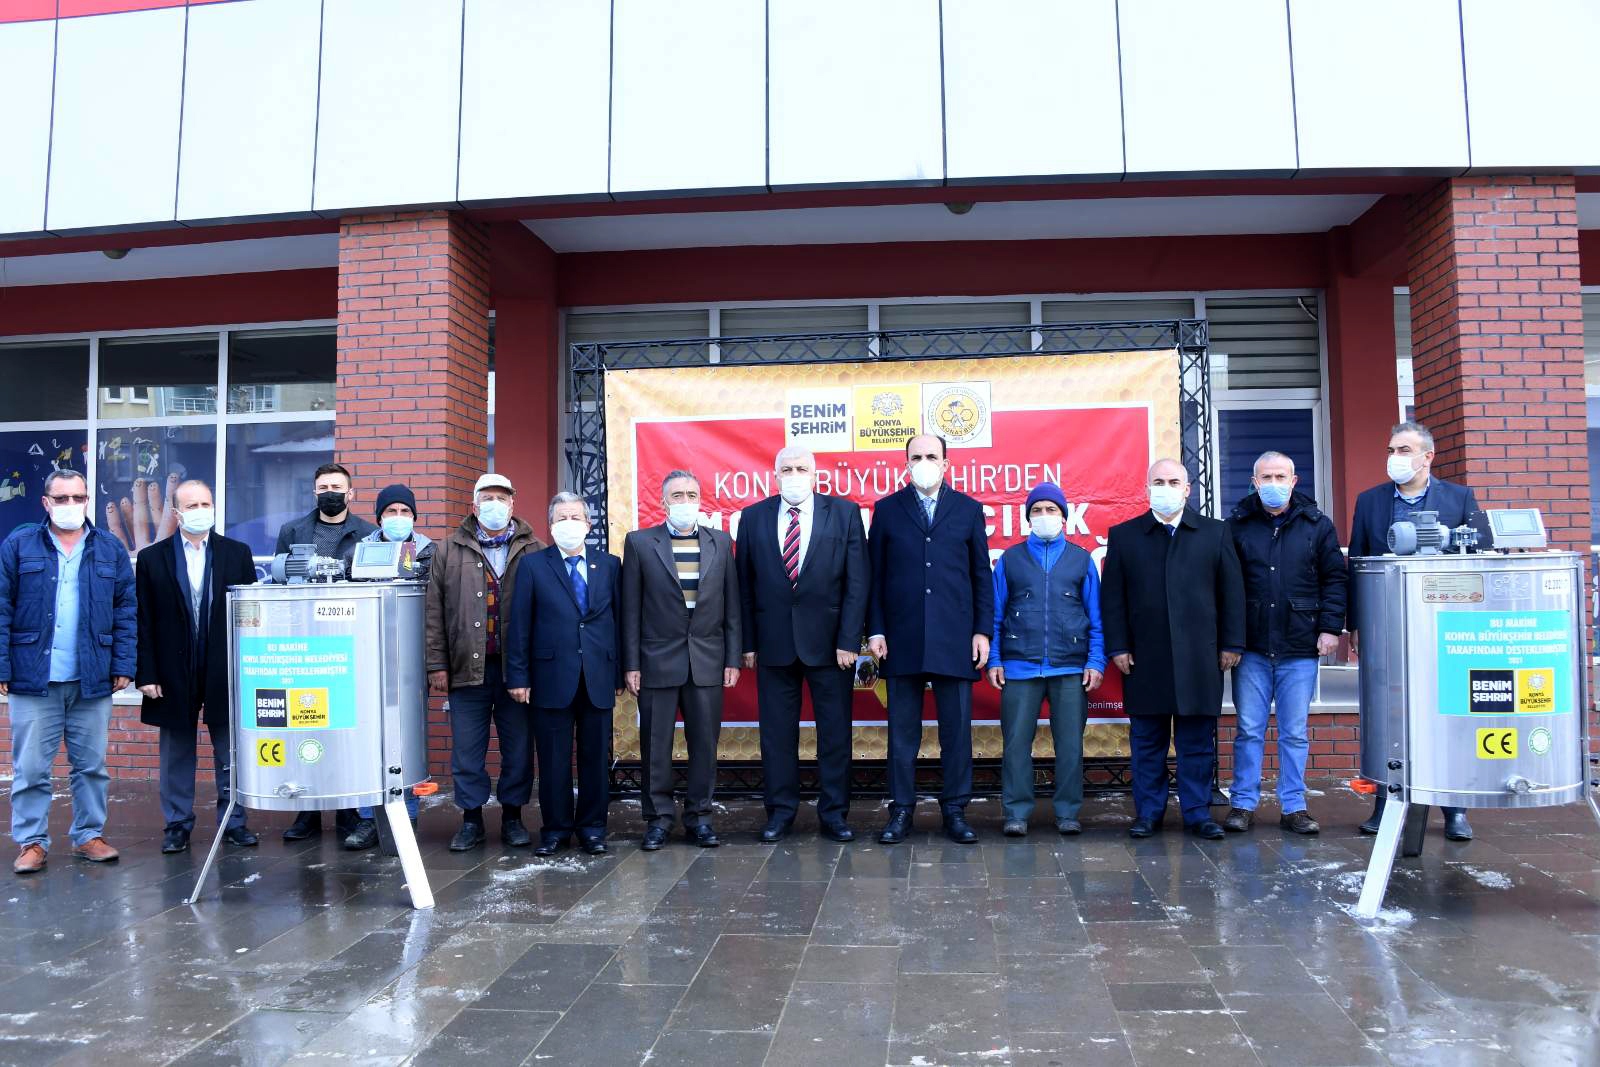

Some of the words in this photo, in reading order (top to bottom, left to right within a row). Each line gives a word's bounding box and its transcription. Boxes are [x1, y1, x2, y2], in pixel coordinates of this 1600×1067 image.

[873, 419, 902, 427] KONYA
[859, 427, 916, 438] BÜYÜKŞEHİR
[316, 607, 355, 616] 42.2021.61
[1444, 632, 1475, 641] KONYA
[1445, 645, 1504, 655] TARAFINDAN
[1482, 732, 1512, 755] CE
[259, 742, 281, 763] CE
